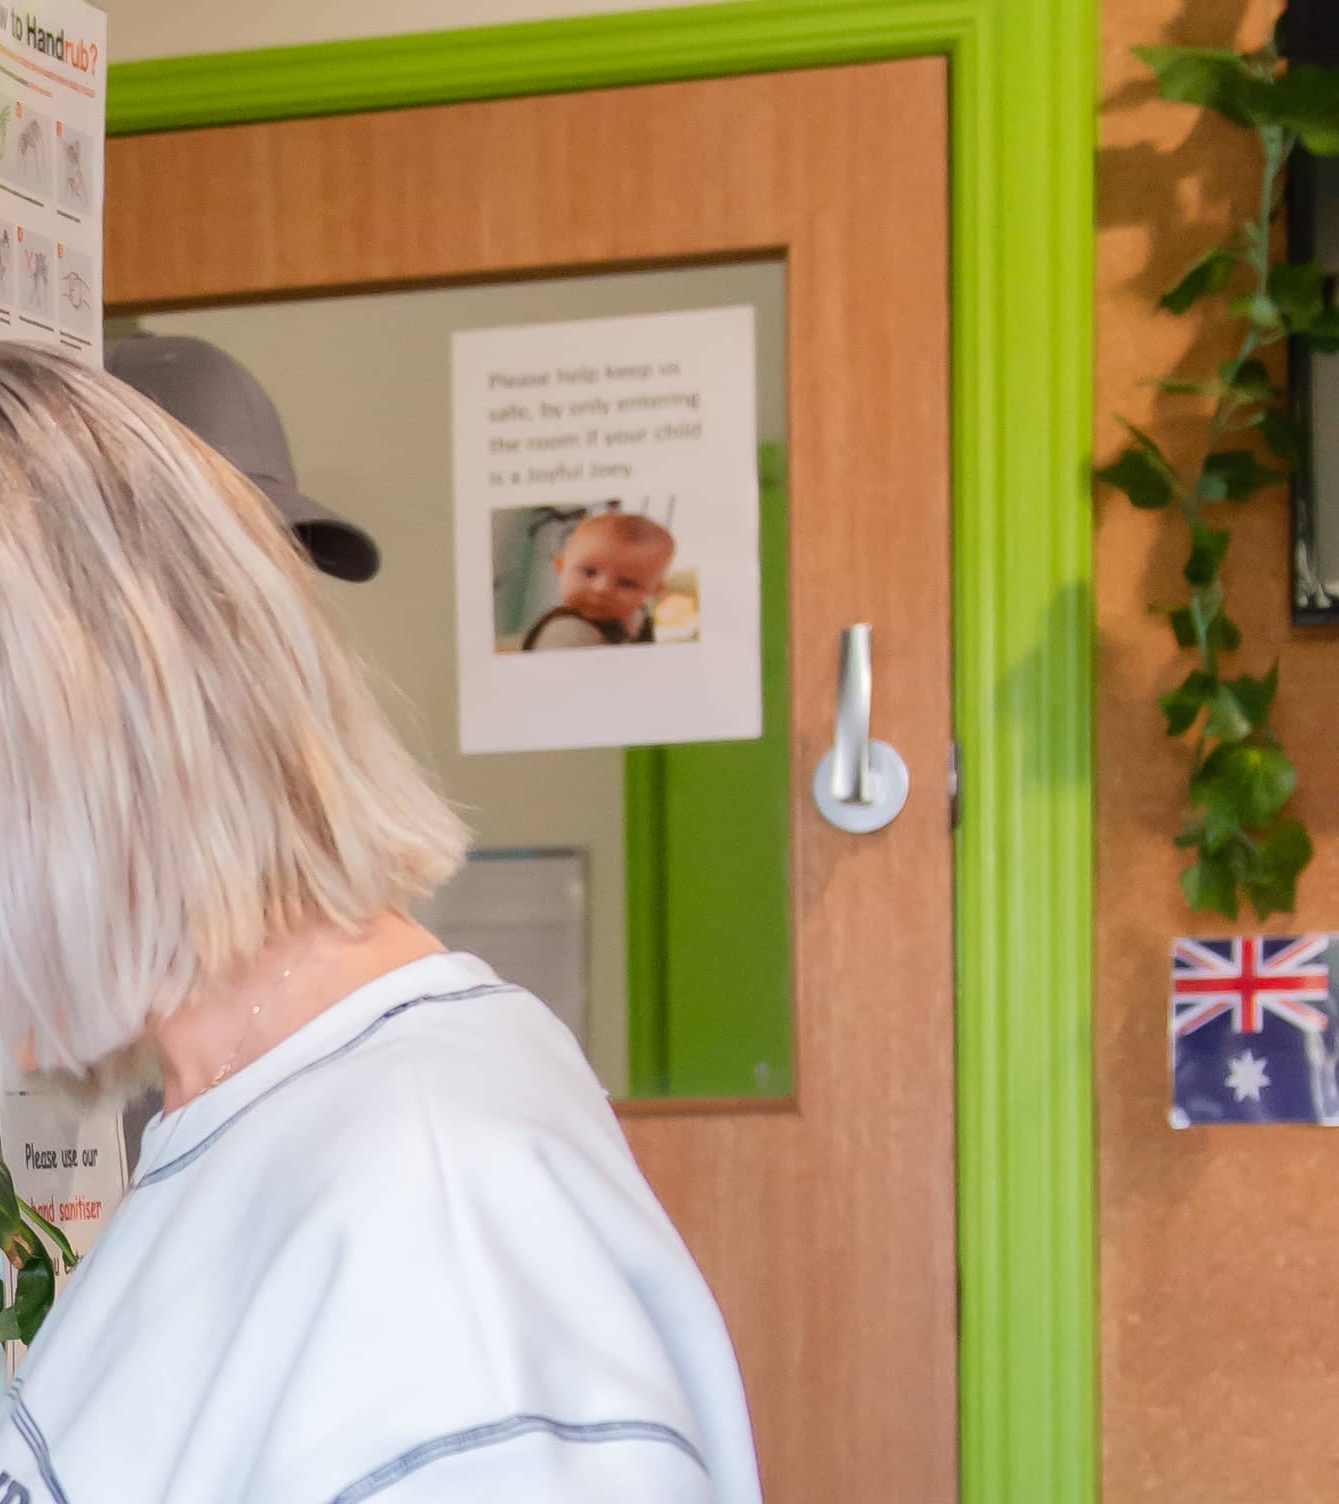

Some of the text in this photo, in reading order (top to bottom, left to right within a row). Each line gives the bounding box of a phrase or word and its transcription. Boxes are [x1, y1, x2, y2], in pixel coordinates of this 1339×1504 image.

[11, 7, 23, 42] to
[26, 13, 98, 76] Handrub?
[488, 362, 680, 389] Please help keep us
[539, 401, 563, 420] by
[568, 397, 609, 418] only
[617, 393, 699, 411] entering
[488, 437, 521, 453] the
[526, 433, 579, 450] room
[604, 429, 647, 447] your
[654, 422, 702, 441] child
[511, 472, 522, 486] a
[25, 1143, 98, 1170] Please use our
[59, 1194, 102, 1222] sanitiser
